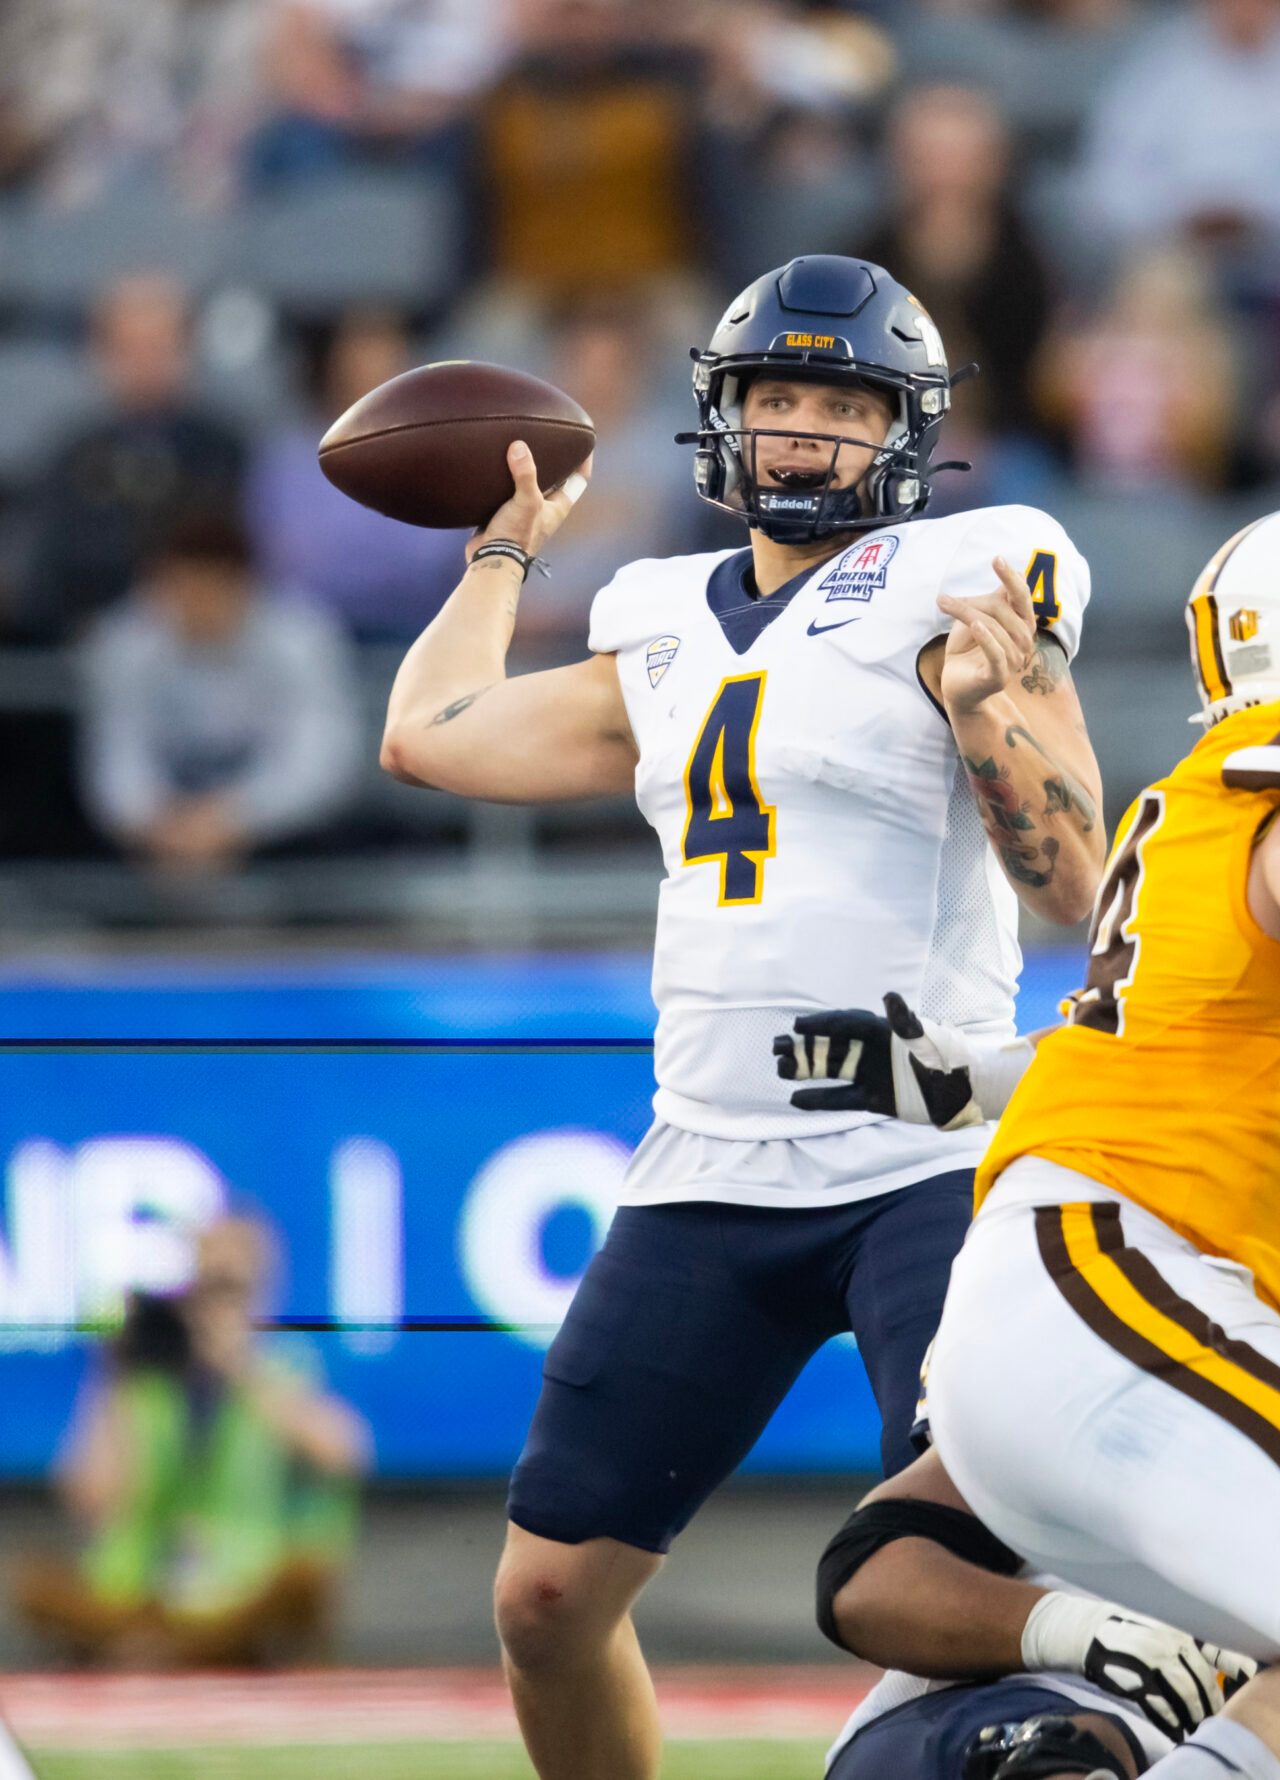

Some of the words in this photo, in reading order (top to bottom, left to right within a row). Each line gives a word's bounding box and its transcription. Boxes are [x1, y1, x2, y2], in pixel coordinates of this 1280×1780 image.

[786, 334, 813, 347] GLASS
[814, 335, 835, 349] CITY
[769, 498, 813, 510] Riddell
[827, 571, 884, 583] ARIZONA
[832, 583, 869, 595] BOWL
[1024, 547, 1063, 630] 4
[680, 669, 778, 908] 4
